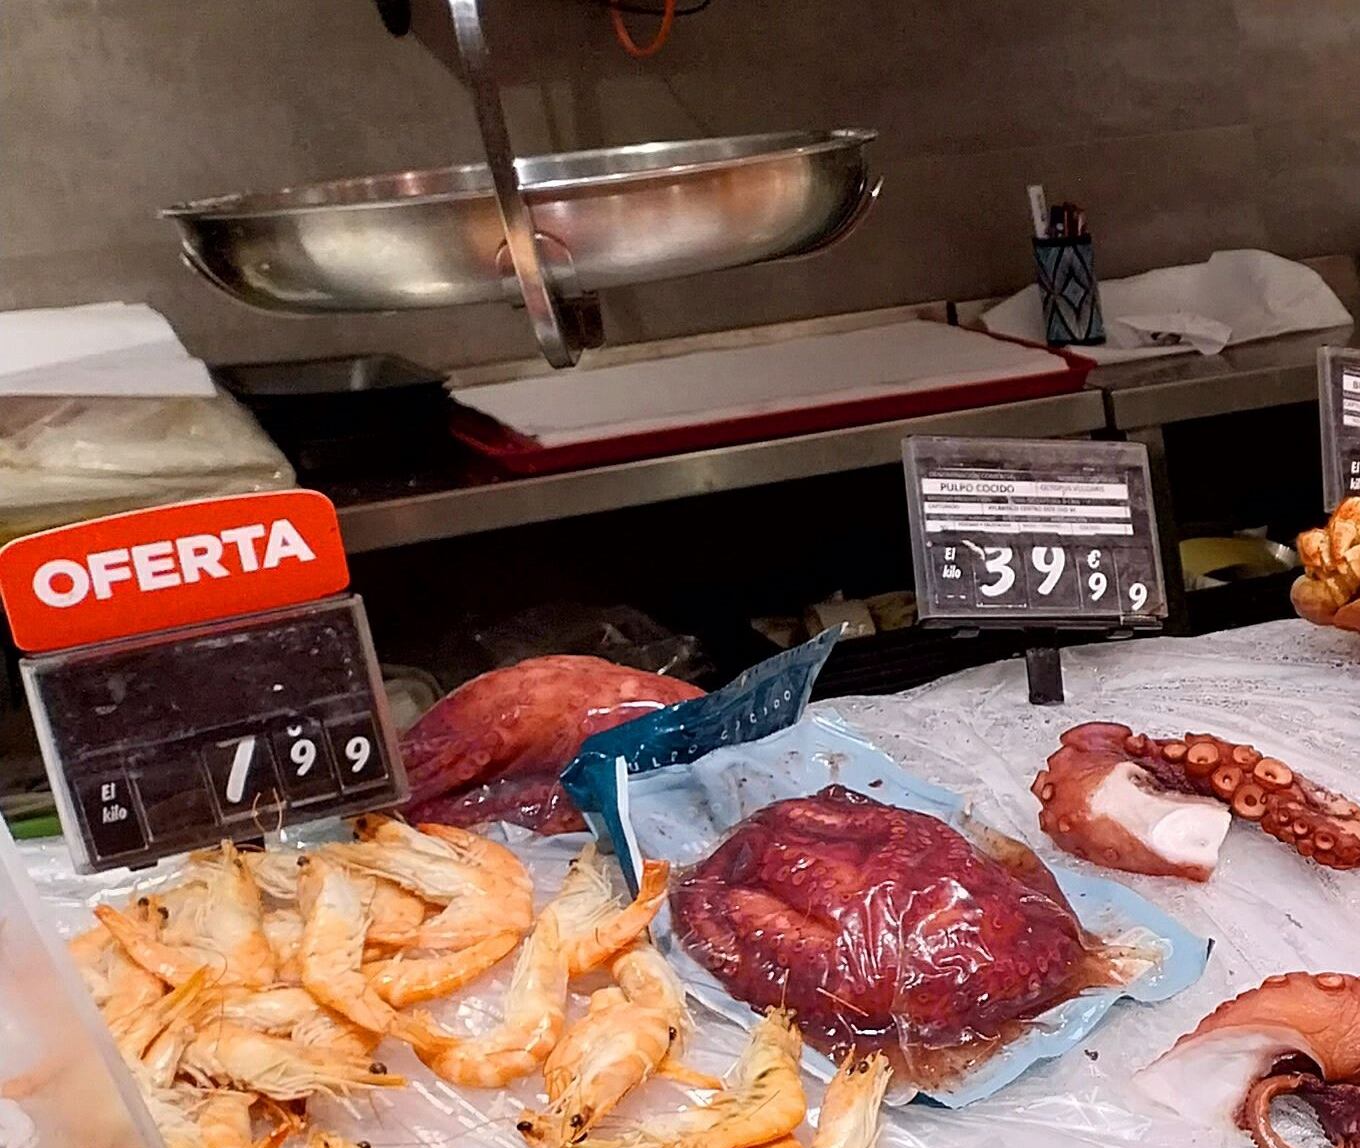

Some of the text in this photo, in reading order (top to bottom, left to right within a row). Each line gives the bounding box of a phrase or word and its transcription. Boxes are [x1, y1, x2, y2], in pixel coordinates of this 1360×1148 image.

[940, 482, 973, 493] PULPO
[976, 484, 1015, 493] COCIDO
[32, 518, 317, 608] OFERTA
[945, 548, 955, 560] El
[942, 565, 961, 579] kilo
[981, 547, 1065, 597] 39
[628, 744, 698, 771] ULPO
[101, 783, 116, 801] El
[102, 805, 127, 824] kilo
